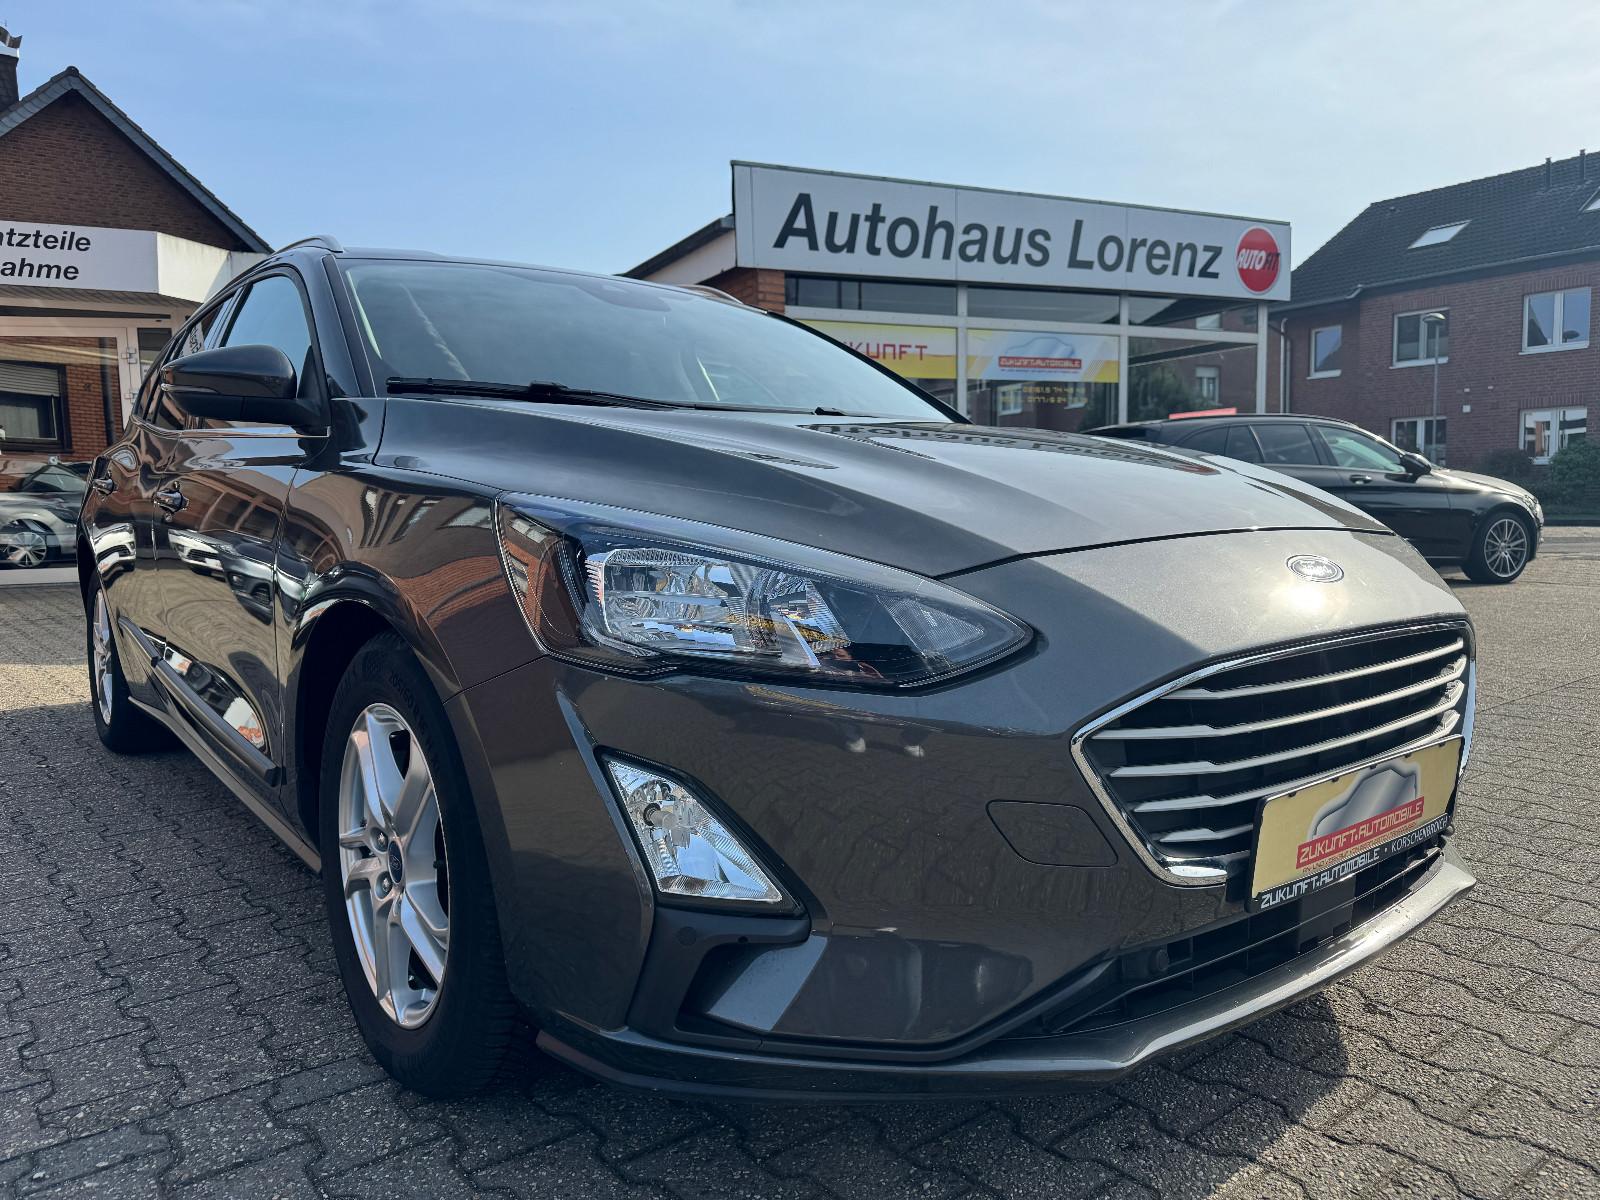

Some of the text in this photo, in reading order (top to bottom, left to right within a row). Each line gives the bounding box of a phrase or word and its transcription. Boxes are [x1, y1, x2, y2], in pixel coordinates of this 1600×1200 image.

[772, 192, 1223, 279] Autohaus Lorenz
[1299, 801, 1423, 863] ZUKUNFT.AUTOMOBILE
[1260, 853, 1380, 909] ZUKUNFT.AUTOMOBILE
